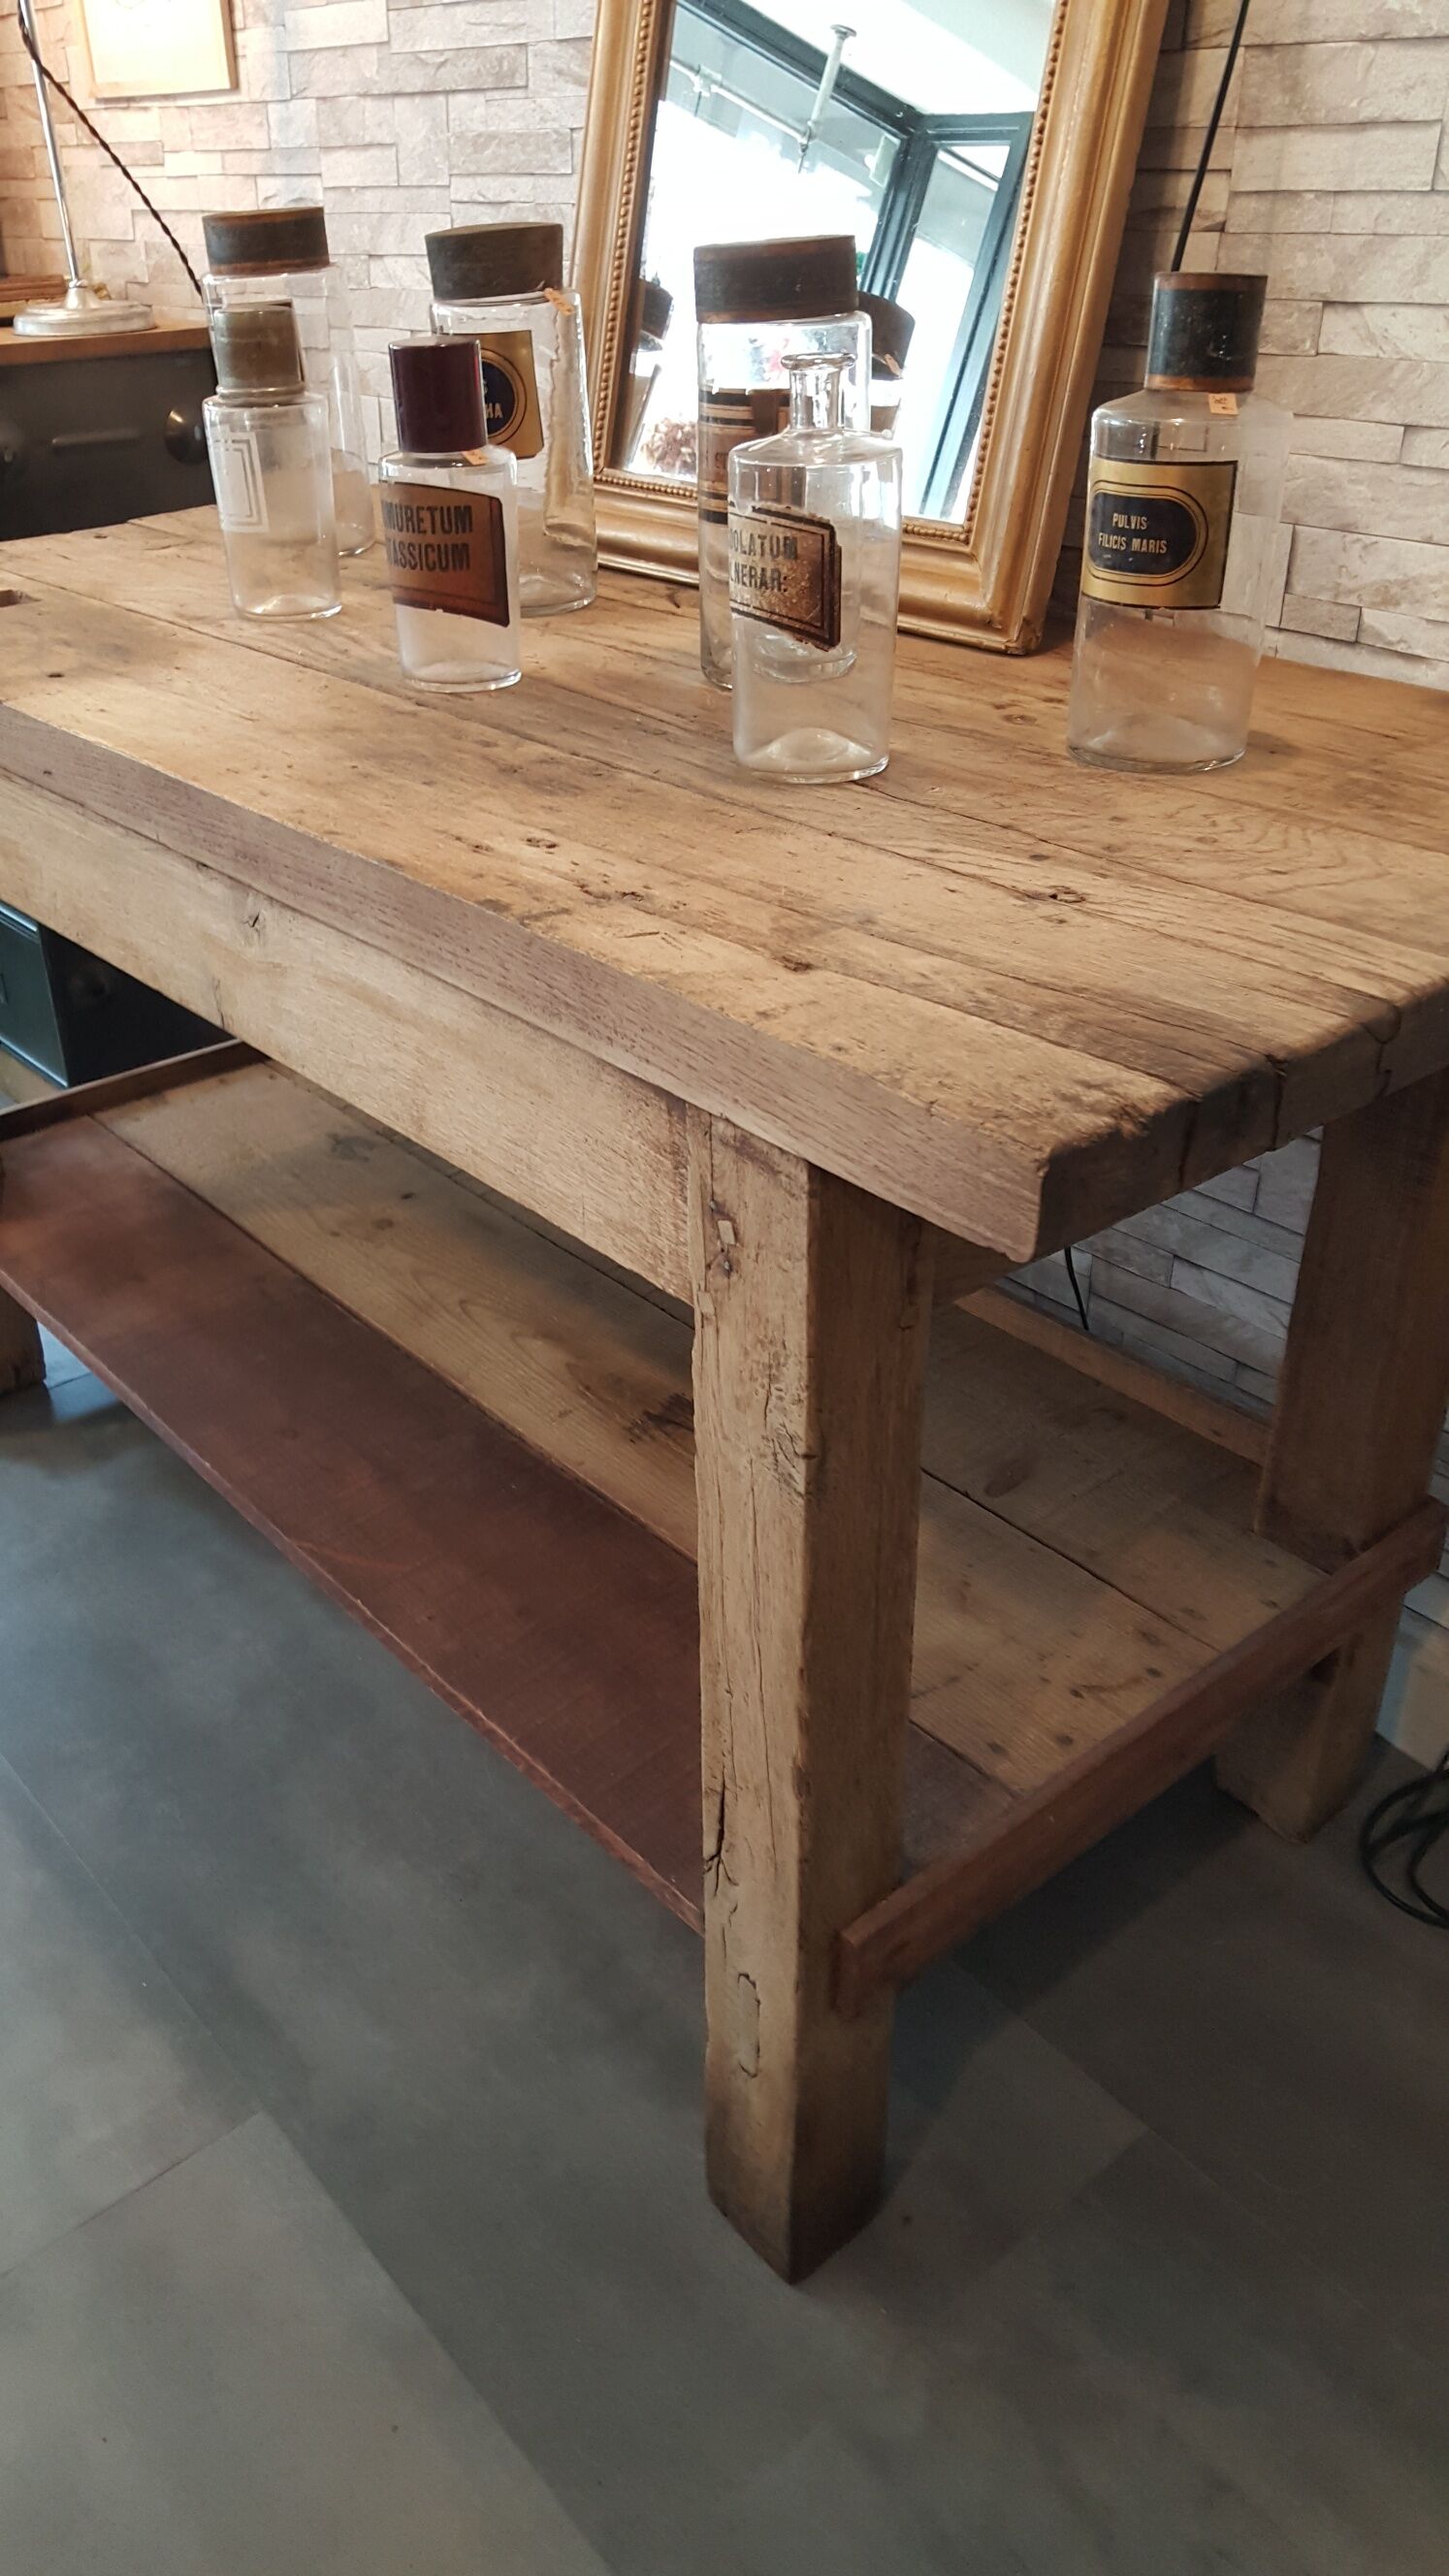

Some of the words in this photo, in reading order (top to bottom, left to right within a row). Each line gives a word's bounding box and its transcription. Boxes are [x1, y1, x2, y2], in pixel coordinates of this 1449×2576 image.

[1111, 512, 1148, 531] PULVIS
[1098, 532, 1127, 551] FILICIS
[1131, 537, 1168, 554] MARIS
